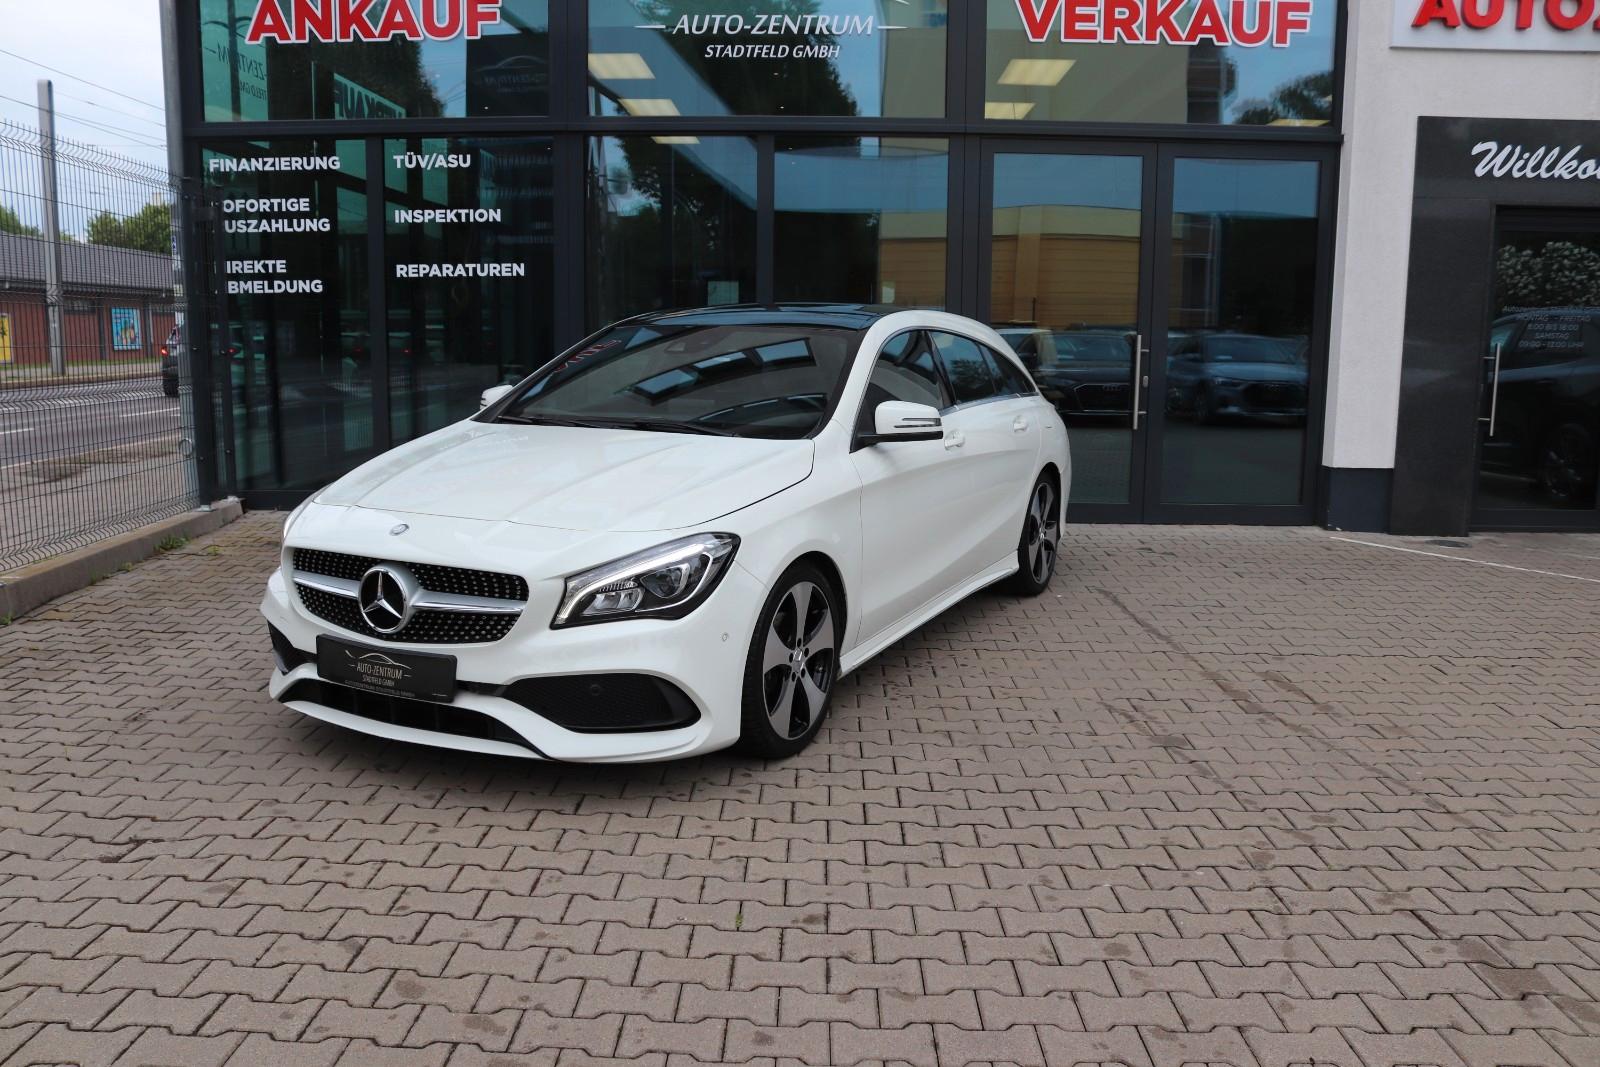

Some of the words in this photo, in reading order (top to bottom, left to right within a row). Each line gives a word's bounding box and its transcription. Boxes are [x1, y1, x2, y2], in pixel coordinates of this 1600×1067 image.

[247, 0, 501, 43] ANKAUF
[1015, 0, 1312, 47] VERKAUF
[1412, 0, 1600, 30] AUTO
[672, 14, 875, 36] AUTO-ZENTRUM
[704, 45, 789, 59] STADTFELD
[792, 44, 840, 59] GMBH
[208, 155, 341, 173] FINANZIERUNG
[393, 151, 471, 171] TÜV/ASU
[1471, 141, 1600, 180] Willko
[222, 197, 310, 213] OFORTIGE
[394, 208, 502, 224] INSPEKTION
[224, 217, 331, 234] USZAHLUNG
[226, 259, 287, 274] IREKTE
[396, 262, 525, 278] REPARATUREN
[227, 279, 323, 294] BMELDUNG
[356, 662, 403, 680] AUTO-ZENTRUM
